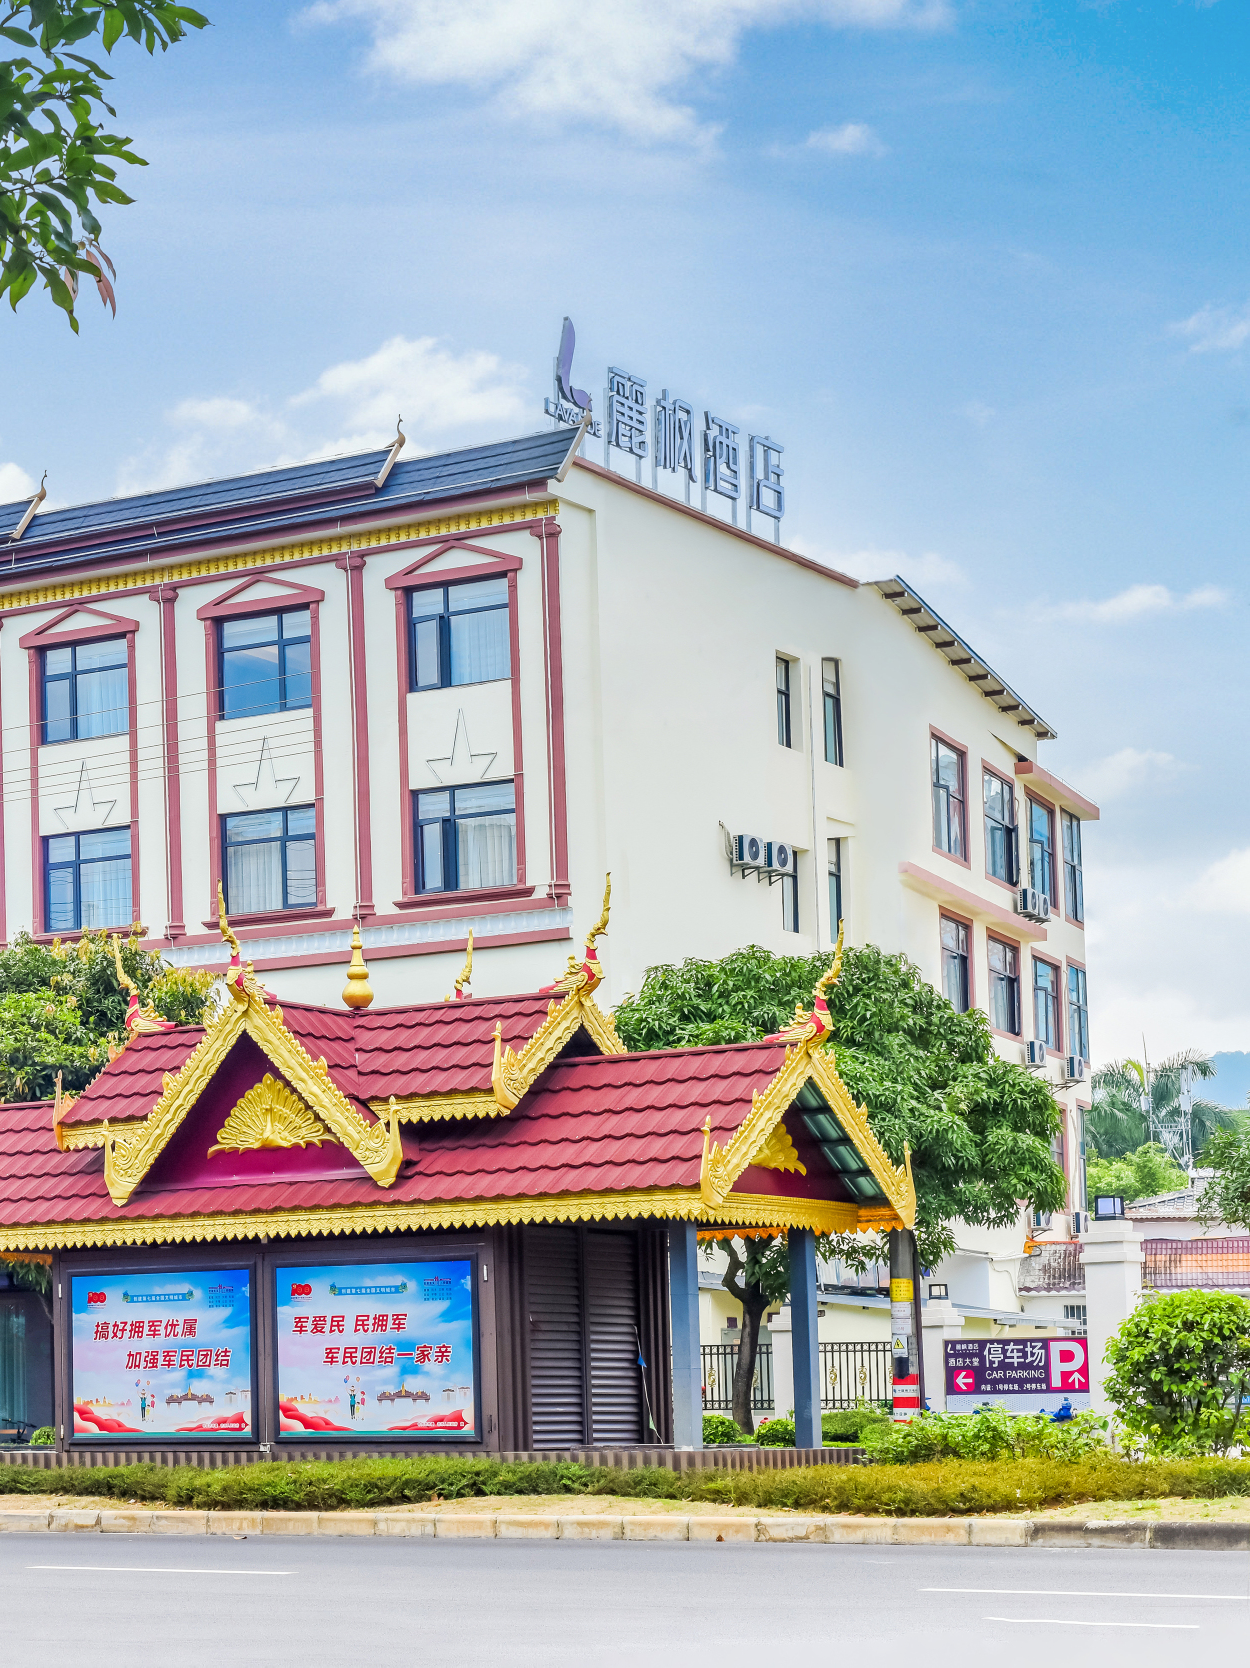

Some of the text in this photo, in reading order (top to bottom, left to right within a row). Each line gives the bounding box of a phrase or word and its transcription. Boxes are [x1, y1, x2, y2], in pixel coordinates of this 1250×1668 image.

[607, 367, 785, 519] 麗枫酒店
[93, 1318, 198, 1341] 搞好拥军优属
[292, 1313, 408, 1335] 军爱民 民拥军
[125, 1347, 232, 1370] 加强军民团结
[322, 1344, 452, 1366] 军民团结一家亲
[948, 1357, 980, 1366] 酒店大堂
[983, 1341, 1045, 1368] 停车场
[985, 1369, 1045, 1379] CAR PARKING
